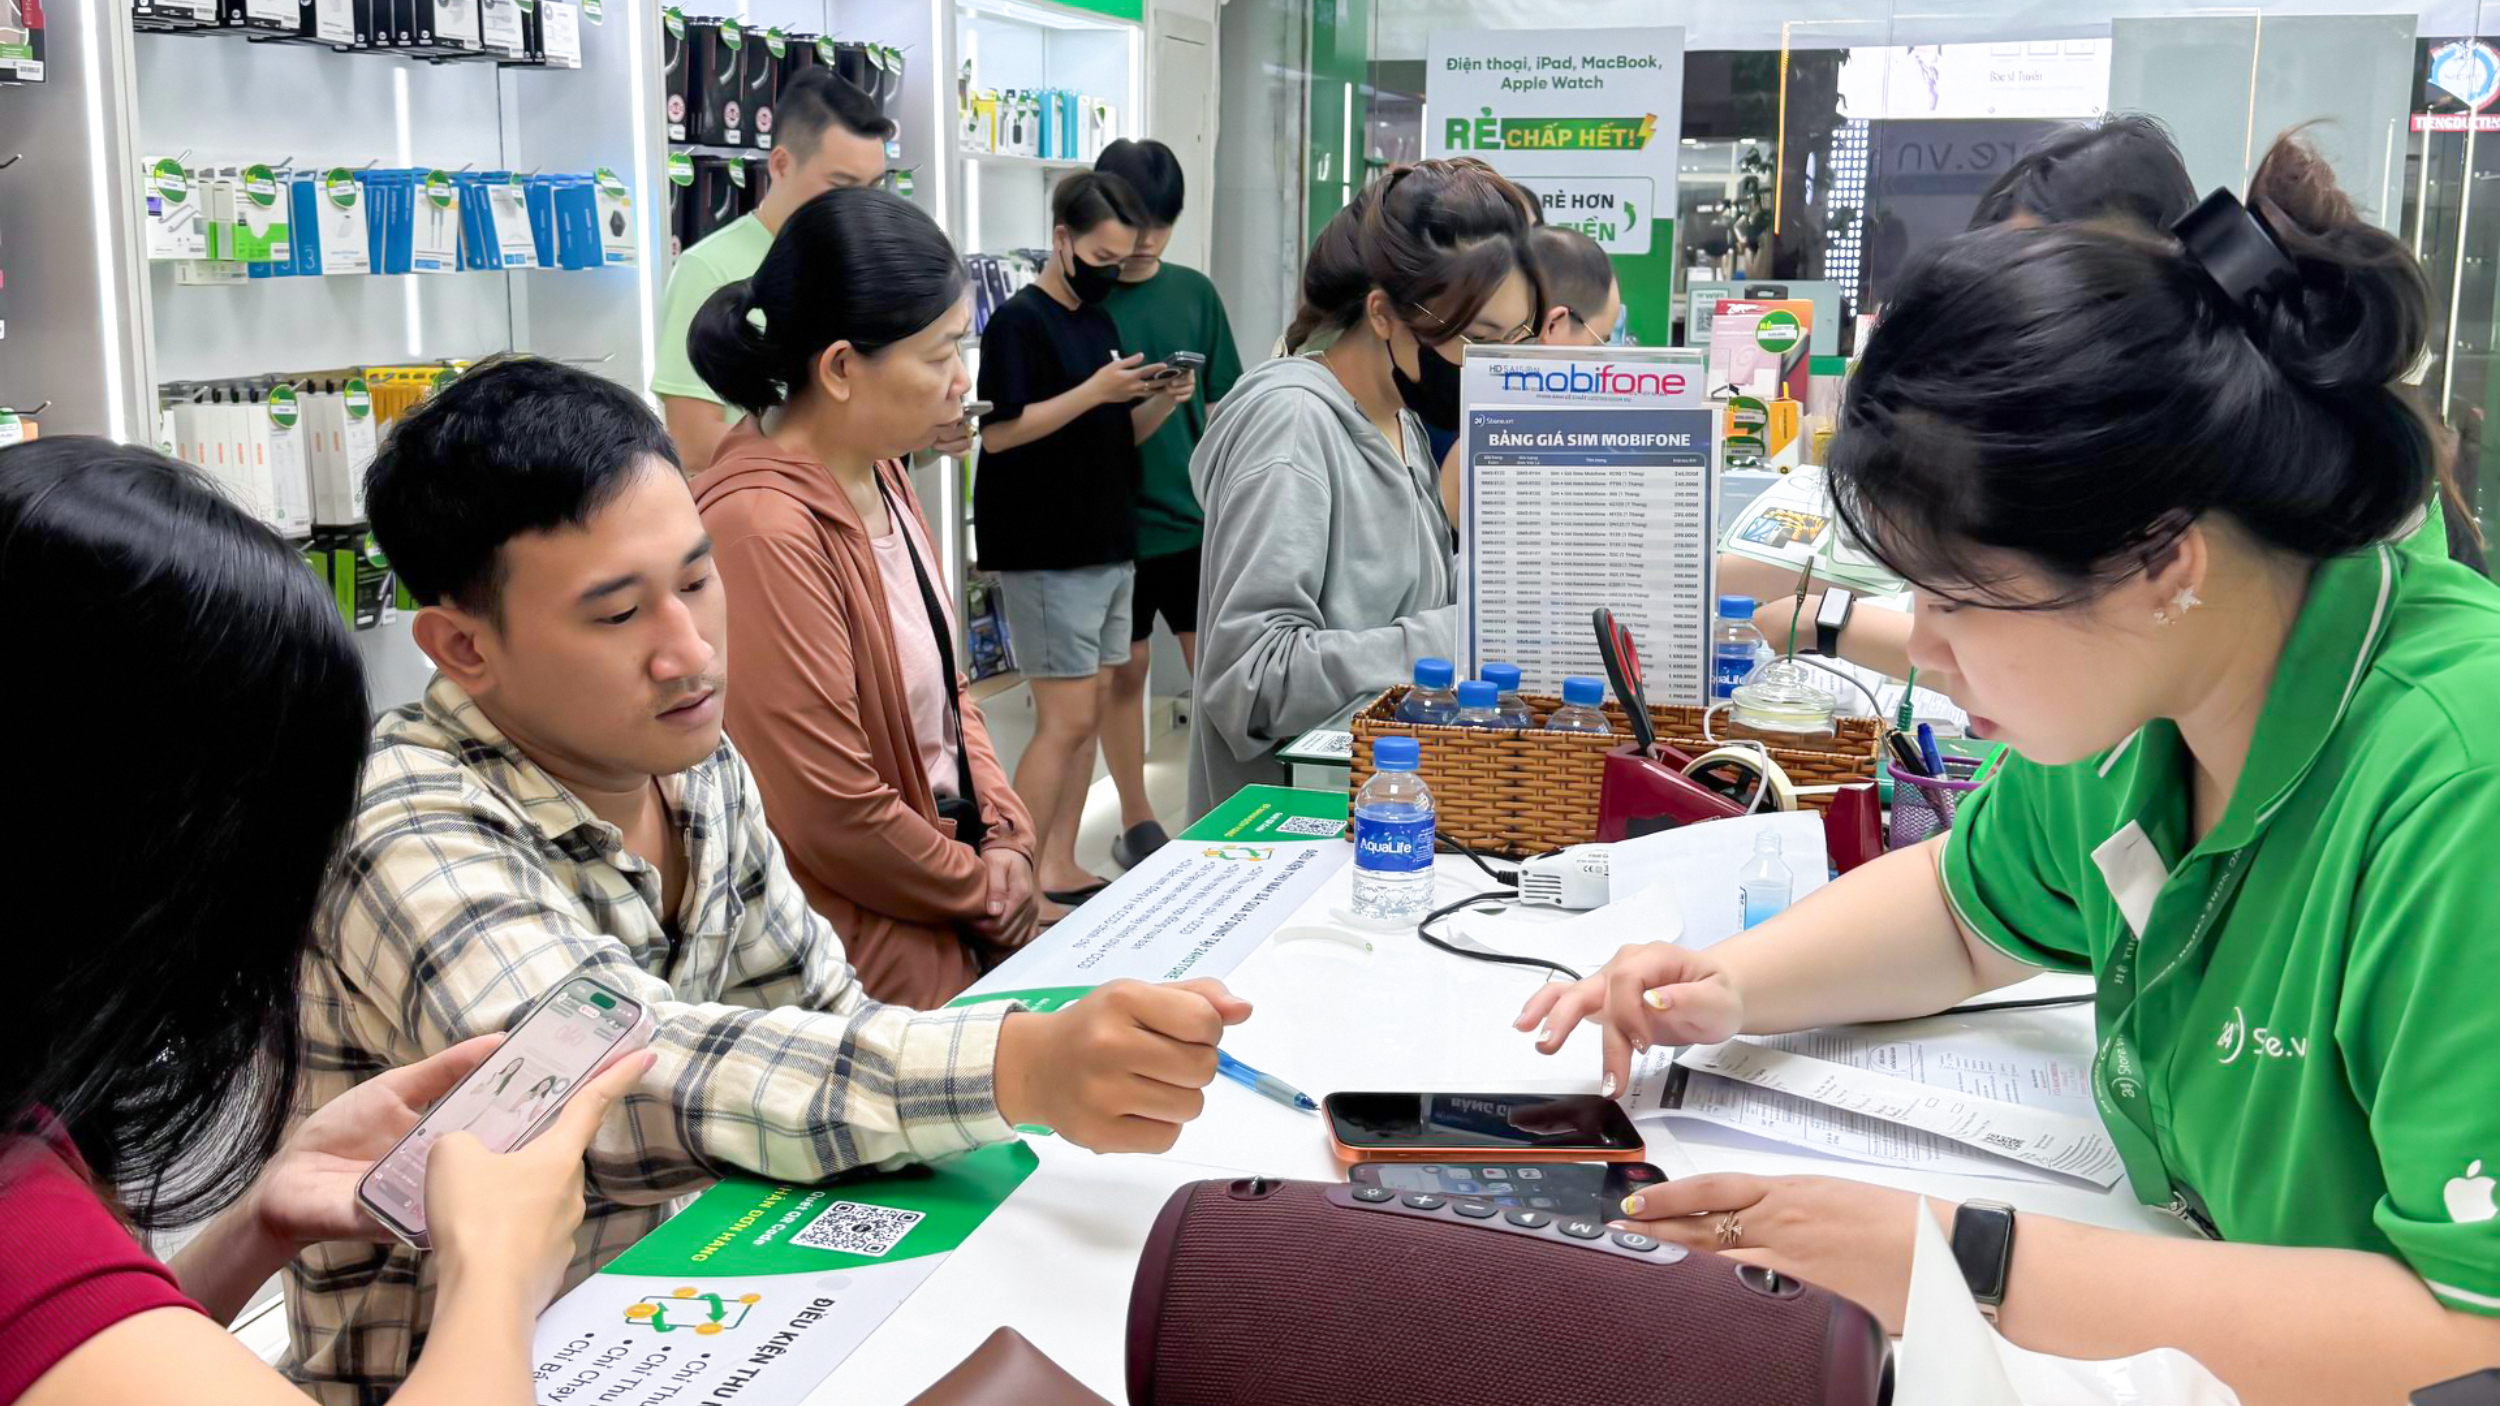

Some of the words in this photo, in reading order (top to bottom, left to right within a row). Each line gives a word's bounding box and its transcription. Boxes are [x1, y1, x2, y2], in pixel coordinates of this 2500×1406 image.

[1446, 57, 1482, 74] Điện
[1486, 56, 1531, 73] thoại,
[1536, 56, 1577, 71] iPad,
[1581, 54, 1662, 70] MacBook,
[1500, 76, 1547, 92] Apple
[1552, 75, 1604, 89] Watch
[1445, 107, 1501, 150] RẺ
[1505, 122, 1572, 147] CHẤP
[1579, 122, 1635, 147] HẾT!
[1542, 190, 1565, 209] RẺ
[1571, 194, 1614, 209] HƠN
[1504, 363, 1686, 395] mobifone
[1489, 429, 1533, 446] BẢNG
[1536, 430, 1564, 447] GIÁ
[1567, 433, 1598, 447] SIM
[1602, 433, 1691, 447] MOBIFONE
[1360, 837, 1412, 855] AquaLife
[795, 1191, 826, 1211] Quét
[729, 1209, 765, 1232] ĐƠN
[779, 1211, 801, 1224] QR
[753, 1223, 785, 1246] Code
[691, 1232, 736, 1262] HÀNG
[789, 1297, 836, 1329] ĐIỀU
[748, 1330, 799, 1365] KIỆN
[548, 1370, 600, 1402] Chạy
[599, 1378, 643, 1402] Thu
[713, 1368, 761, 1399] THU
